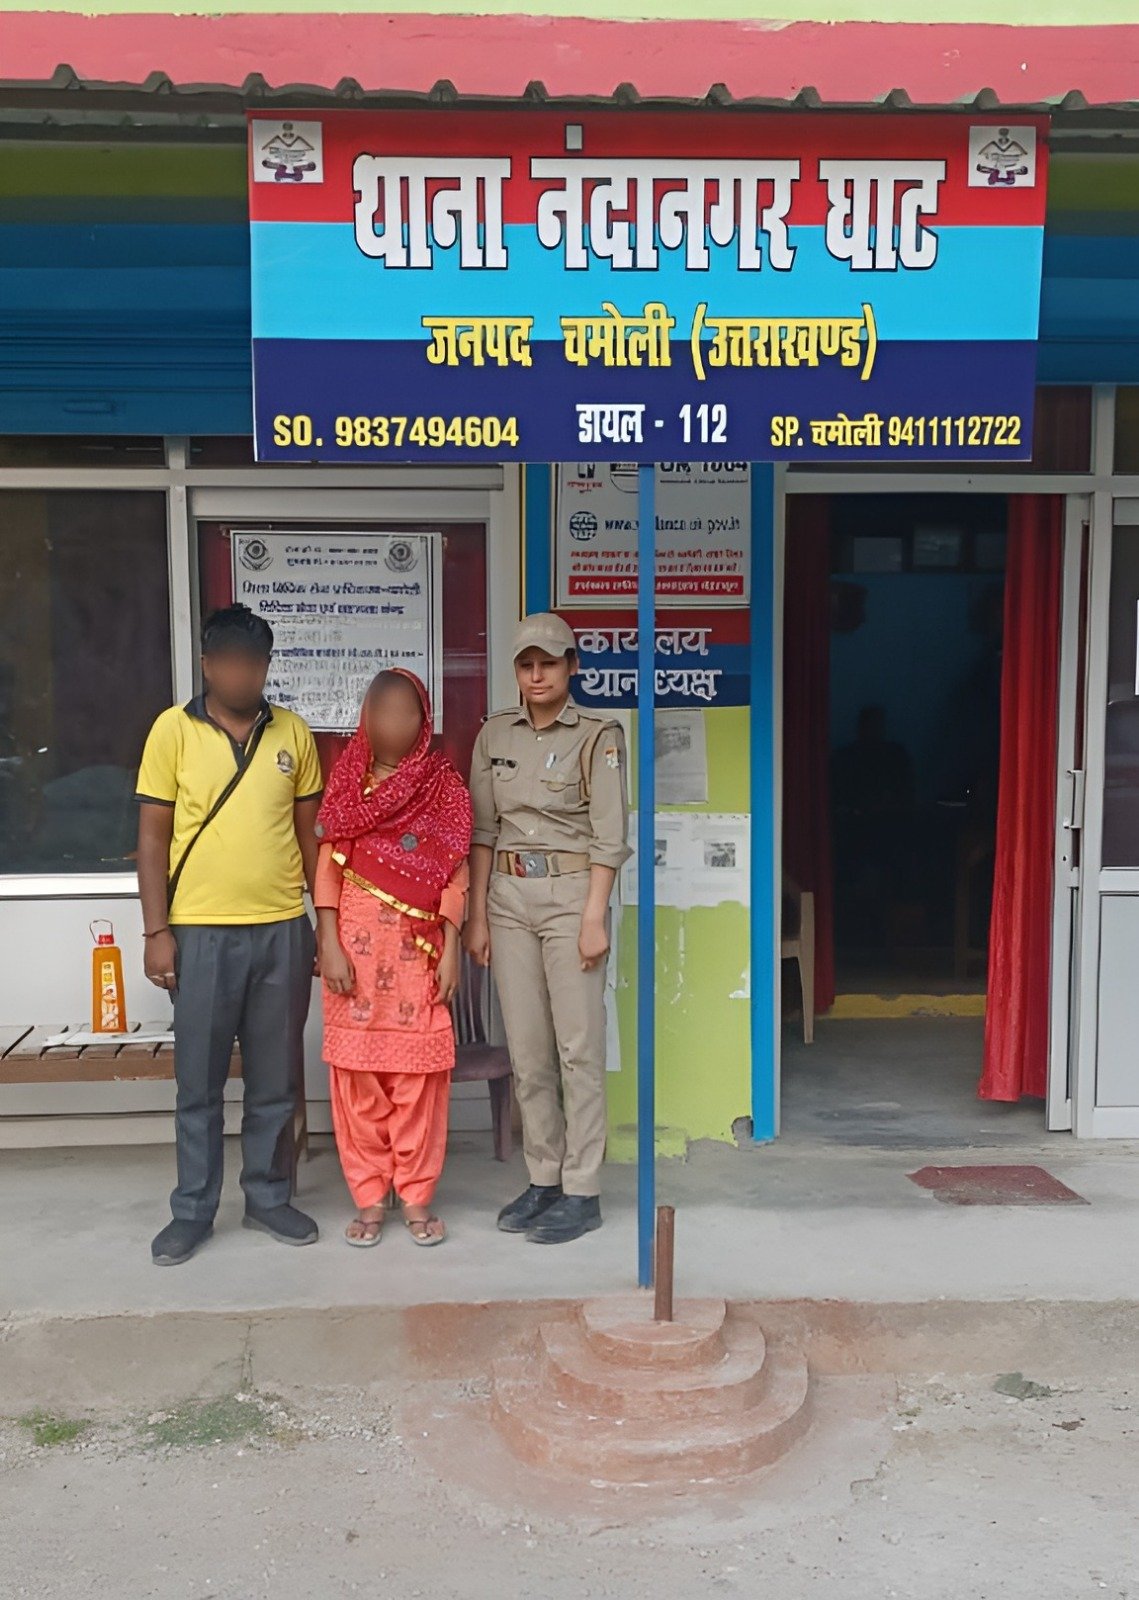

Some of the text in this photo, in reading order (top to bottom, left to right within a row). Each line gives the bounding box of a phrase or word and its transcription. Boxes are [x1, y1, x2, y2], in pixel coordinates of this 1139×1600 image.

[353, 123, 946, 271] थाना नंदानगर घाट
[421, 301, 878, 381] जनपद चमोली (उत्तराखण्ड)
[273, 415, 519, 447] SO. 9837494604
[576, 404, 645, 443] डायल
[679, 404, 727, 443] 112
[771, 413, 1021, 446] SP. चमोली 9411112722
